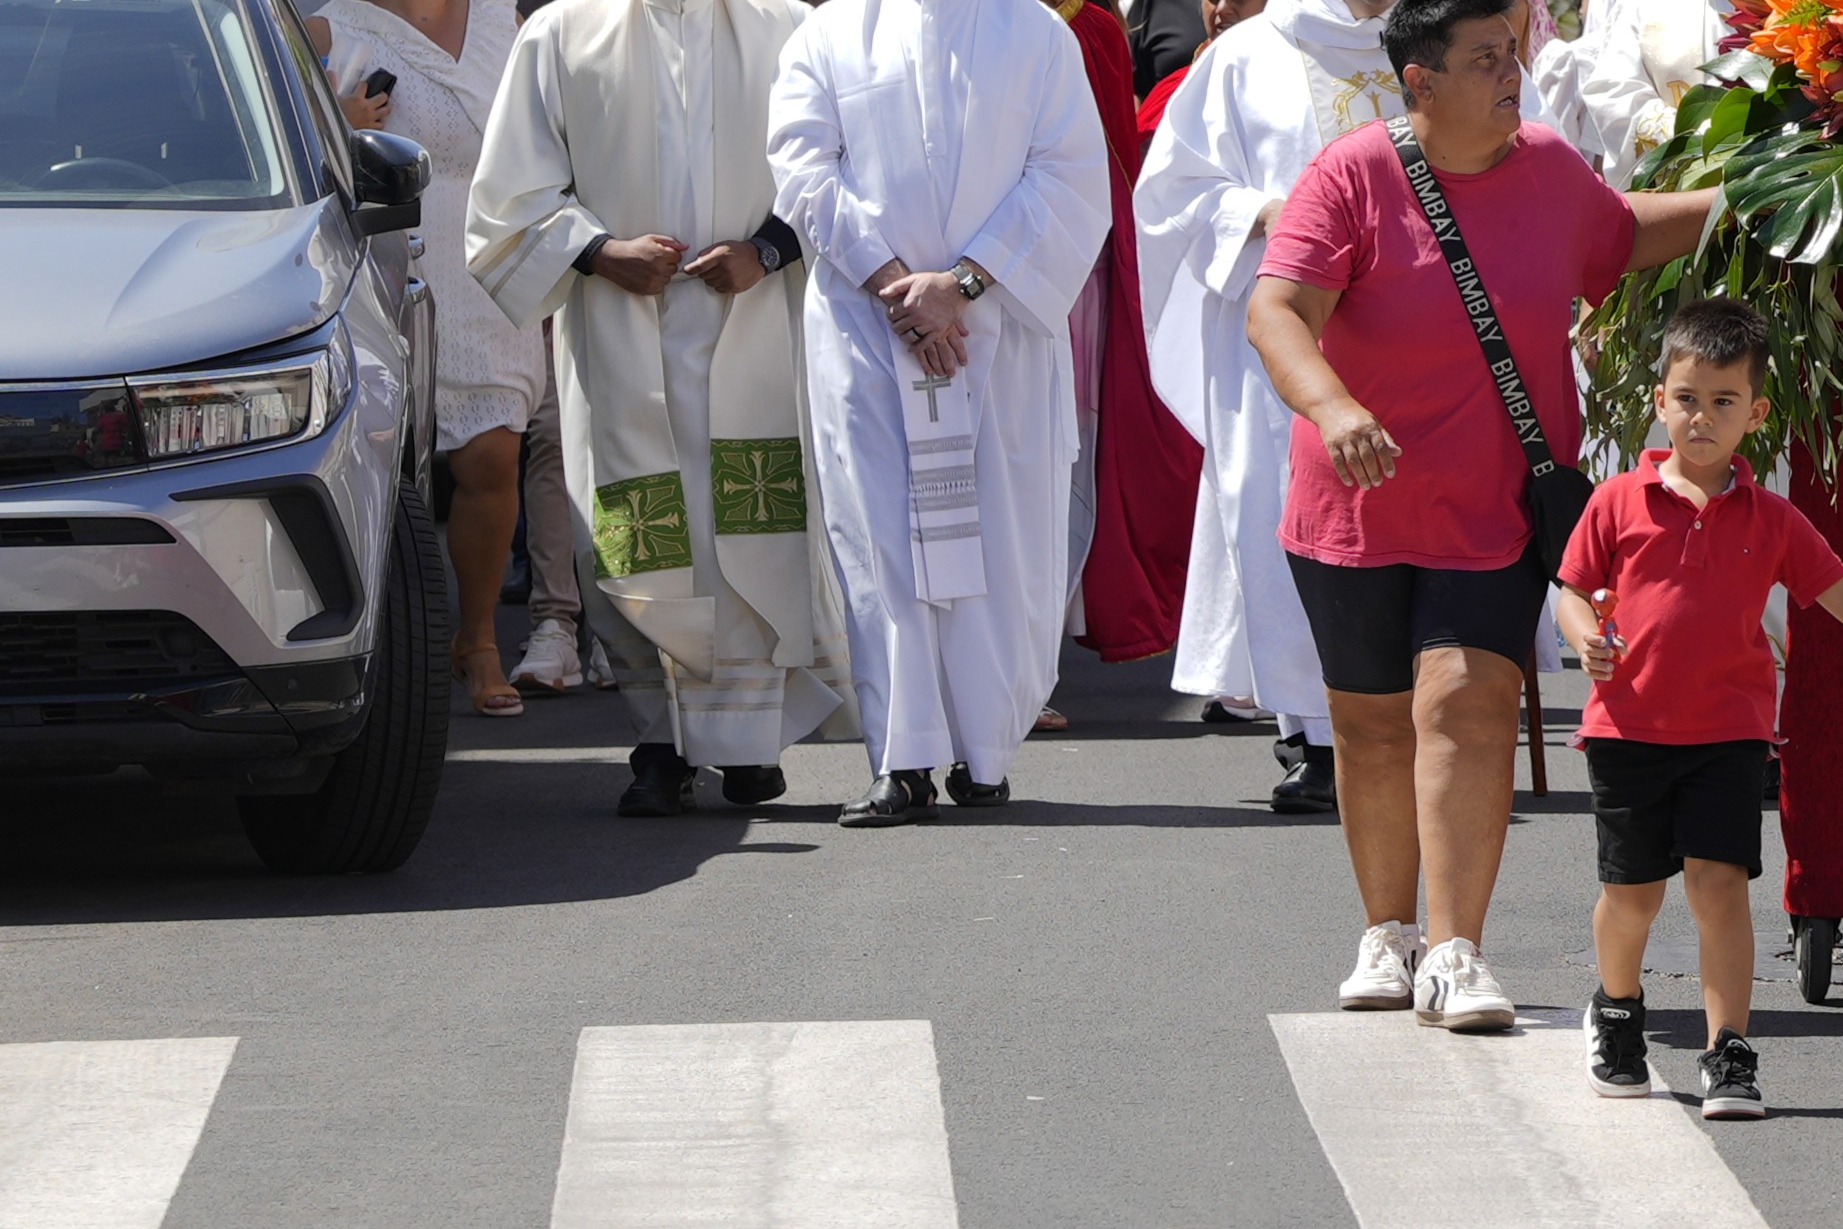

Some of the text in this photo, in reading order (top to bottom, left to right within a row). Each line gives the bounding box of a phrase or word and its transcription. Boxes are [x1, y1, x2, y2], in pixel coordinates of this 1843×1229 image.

[1405, 159, 1461, 242] BIMBAY
[1450, 257, 1503, 342] BIMBAY
[1491, 357, 1544, 444] BIMBAY
